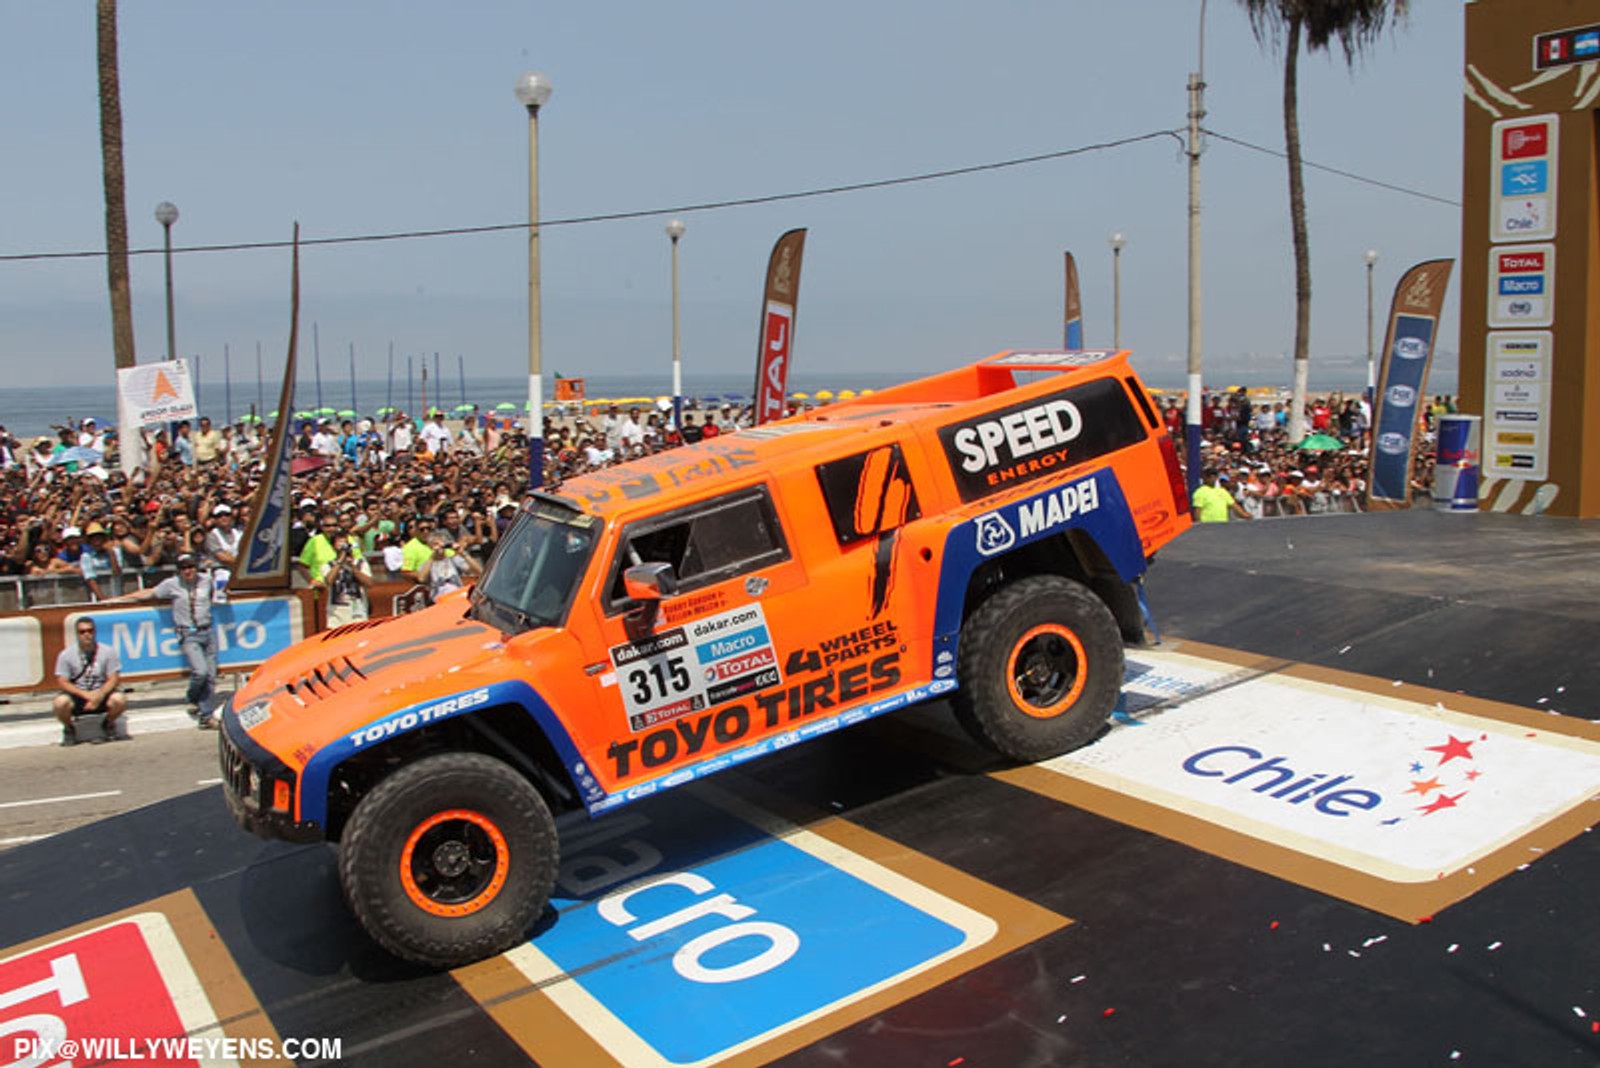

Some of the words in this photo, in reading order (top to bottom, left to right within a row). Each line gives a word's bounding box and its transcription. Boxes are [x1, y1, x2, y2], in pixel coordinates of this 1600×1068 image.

[1506, 217, 1533, 230] Chile
[1502, 257, 1541, 268] TOTAL
[1503, 280, 1539, 291] Macro
[764, 323, 785, 422] TAL
[954, 399, 1082, 473] SPEED
[987, 449, 1068, 486] ENERGY
[1018, 477, 1099, 538] MAPEI
[112, 620, 267, 659] Maro
[694, 610, 757, 637] dakar.com
[617, 635, 684, 661] dakar.com
[710, 635, 755, 658] Macro
[719, 654, 773, 676] TOTAL
[785, 648, 822, 676] 4
[820, 620, 897, 652] WHEEL
[824, 633, 897, 666] PARTS
[628, 655, 691, 704] 315
[349, 714, 418, 747] TOYO
[421, 688, 490, 723] TIRES
[607, 704, 749, 778] TOYO
[756, 651, 901, 727] TIRES
[657, 704, 689, 718] TOTAL
[1182, 745, 1382, 817] Chile
